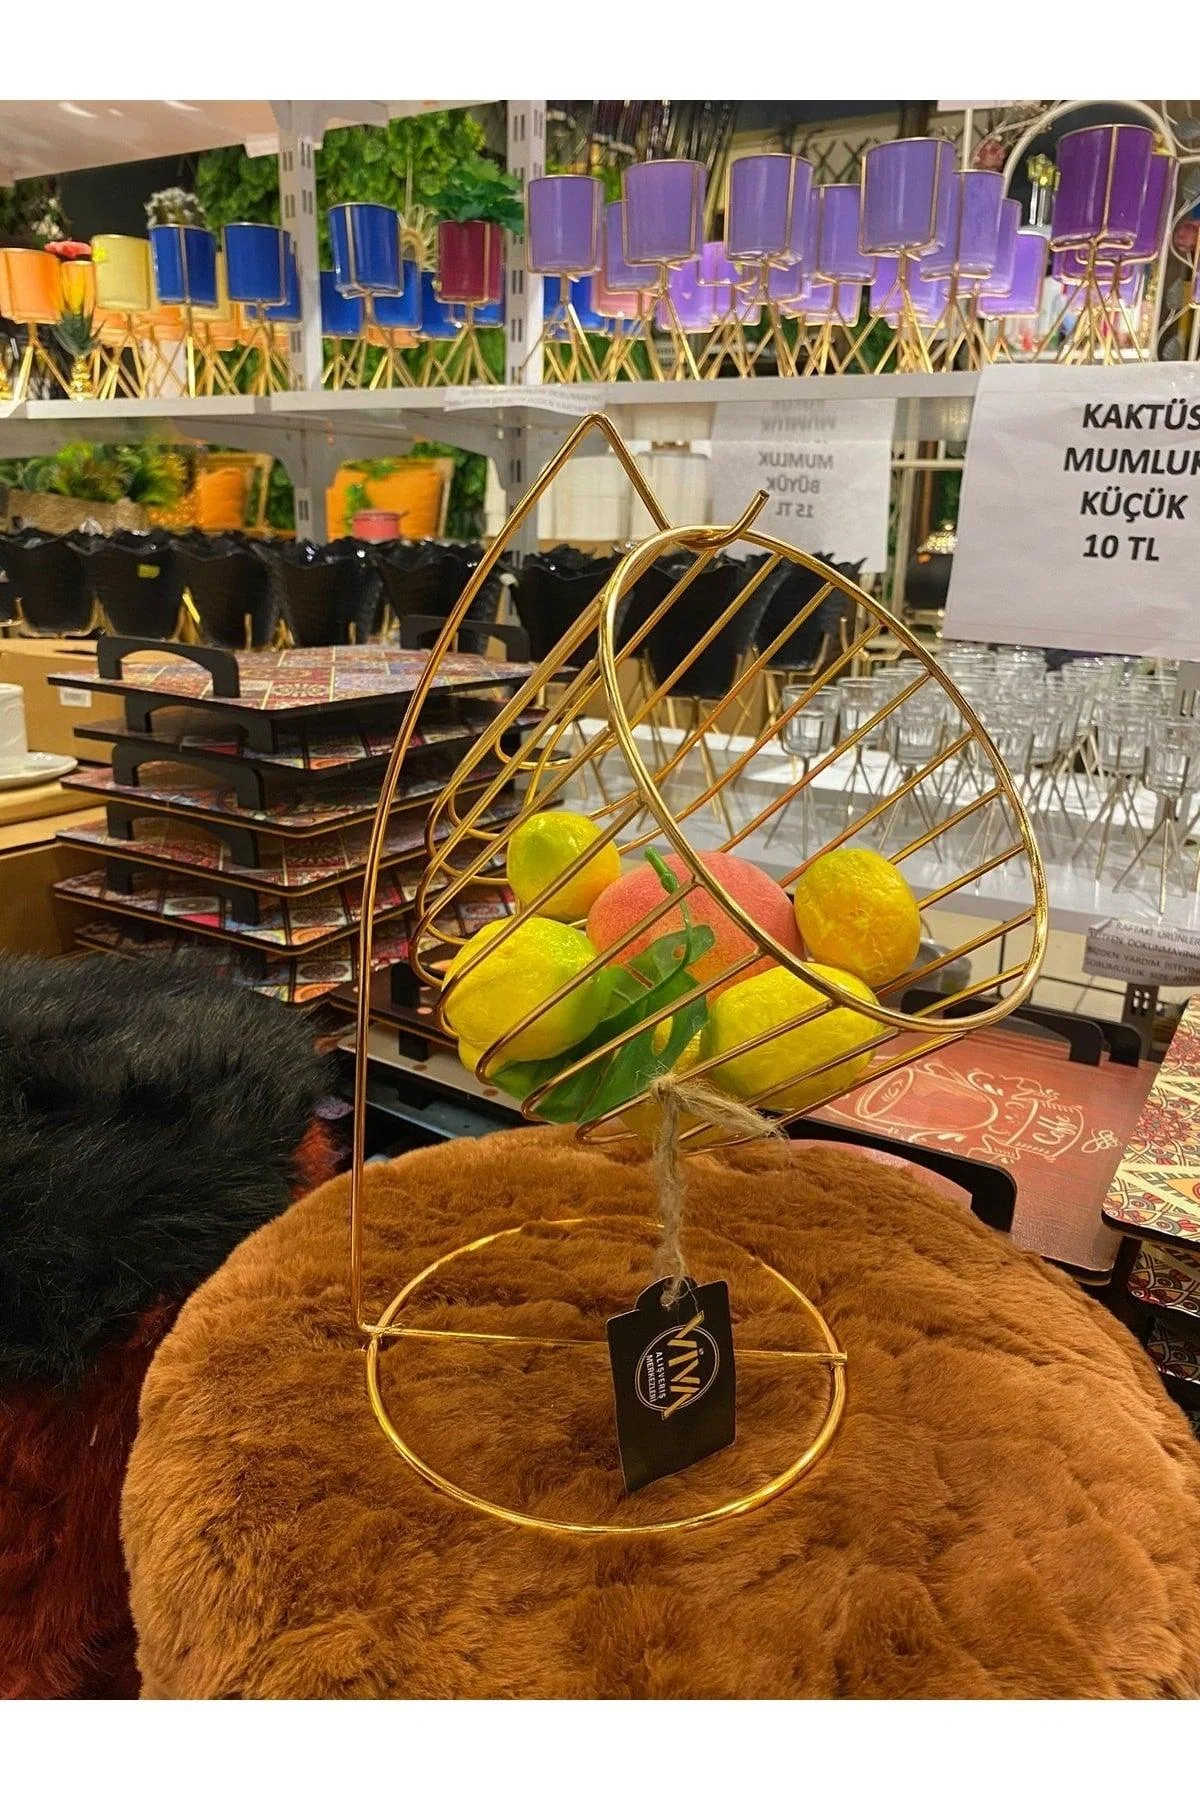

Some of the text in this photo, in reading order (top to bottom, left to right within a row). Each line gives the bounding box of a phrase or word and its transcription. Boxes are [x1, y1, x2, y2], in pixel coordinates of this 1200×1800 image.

[1082, 398, 1200, 431] KAKTÜS
[1080, 485, 1189, 523] KÜÇÜK
[1082, 534, 1160, 562] 10 TL
